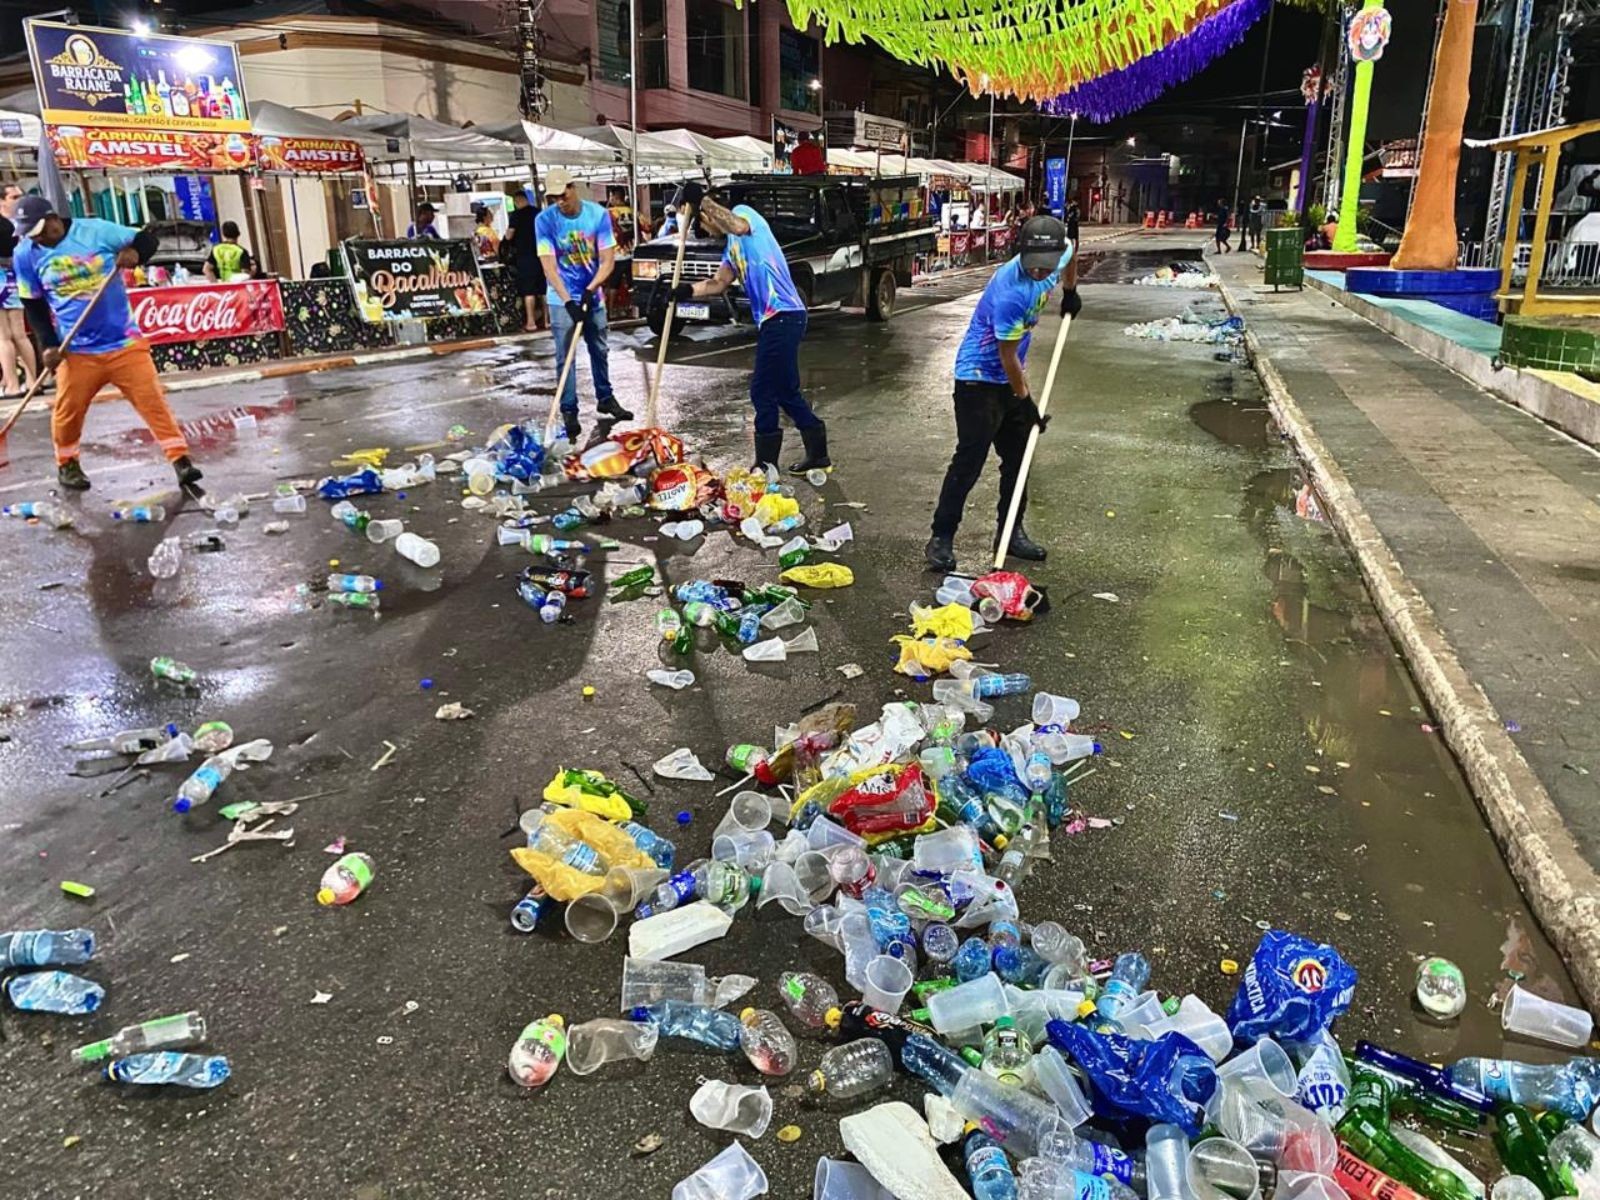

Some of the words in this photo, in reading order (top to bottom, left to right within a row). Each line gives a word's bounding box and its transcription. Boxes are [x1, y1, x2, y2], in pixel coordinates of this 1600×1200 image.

[51, 64, 105, 81] BARRACA
[106, 69, 123, 82] DA
[65, 77, 113, 92] RAIANE
[86, 131, 173, 142] CARNAVAL
[88, 140, 191, 157] AMSTEL
[283, 140, 349, 151] CARNAVAL
[284, 149, 359, 162] AMSTEL
[367, 247, 428, 260] BARRACA
[391, 261, 413, 273] DO
[370, 265, 472, 309] Bacalhau
